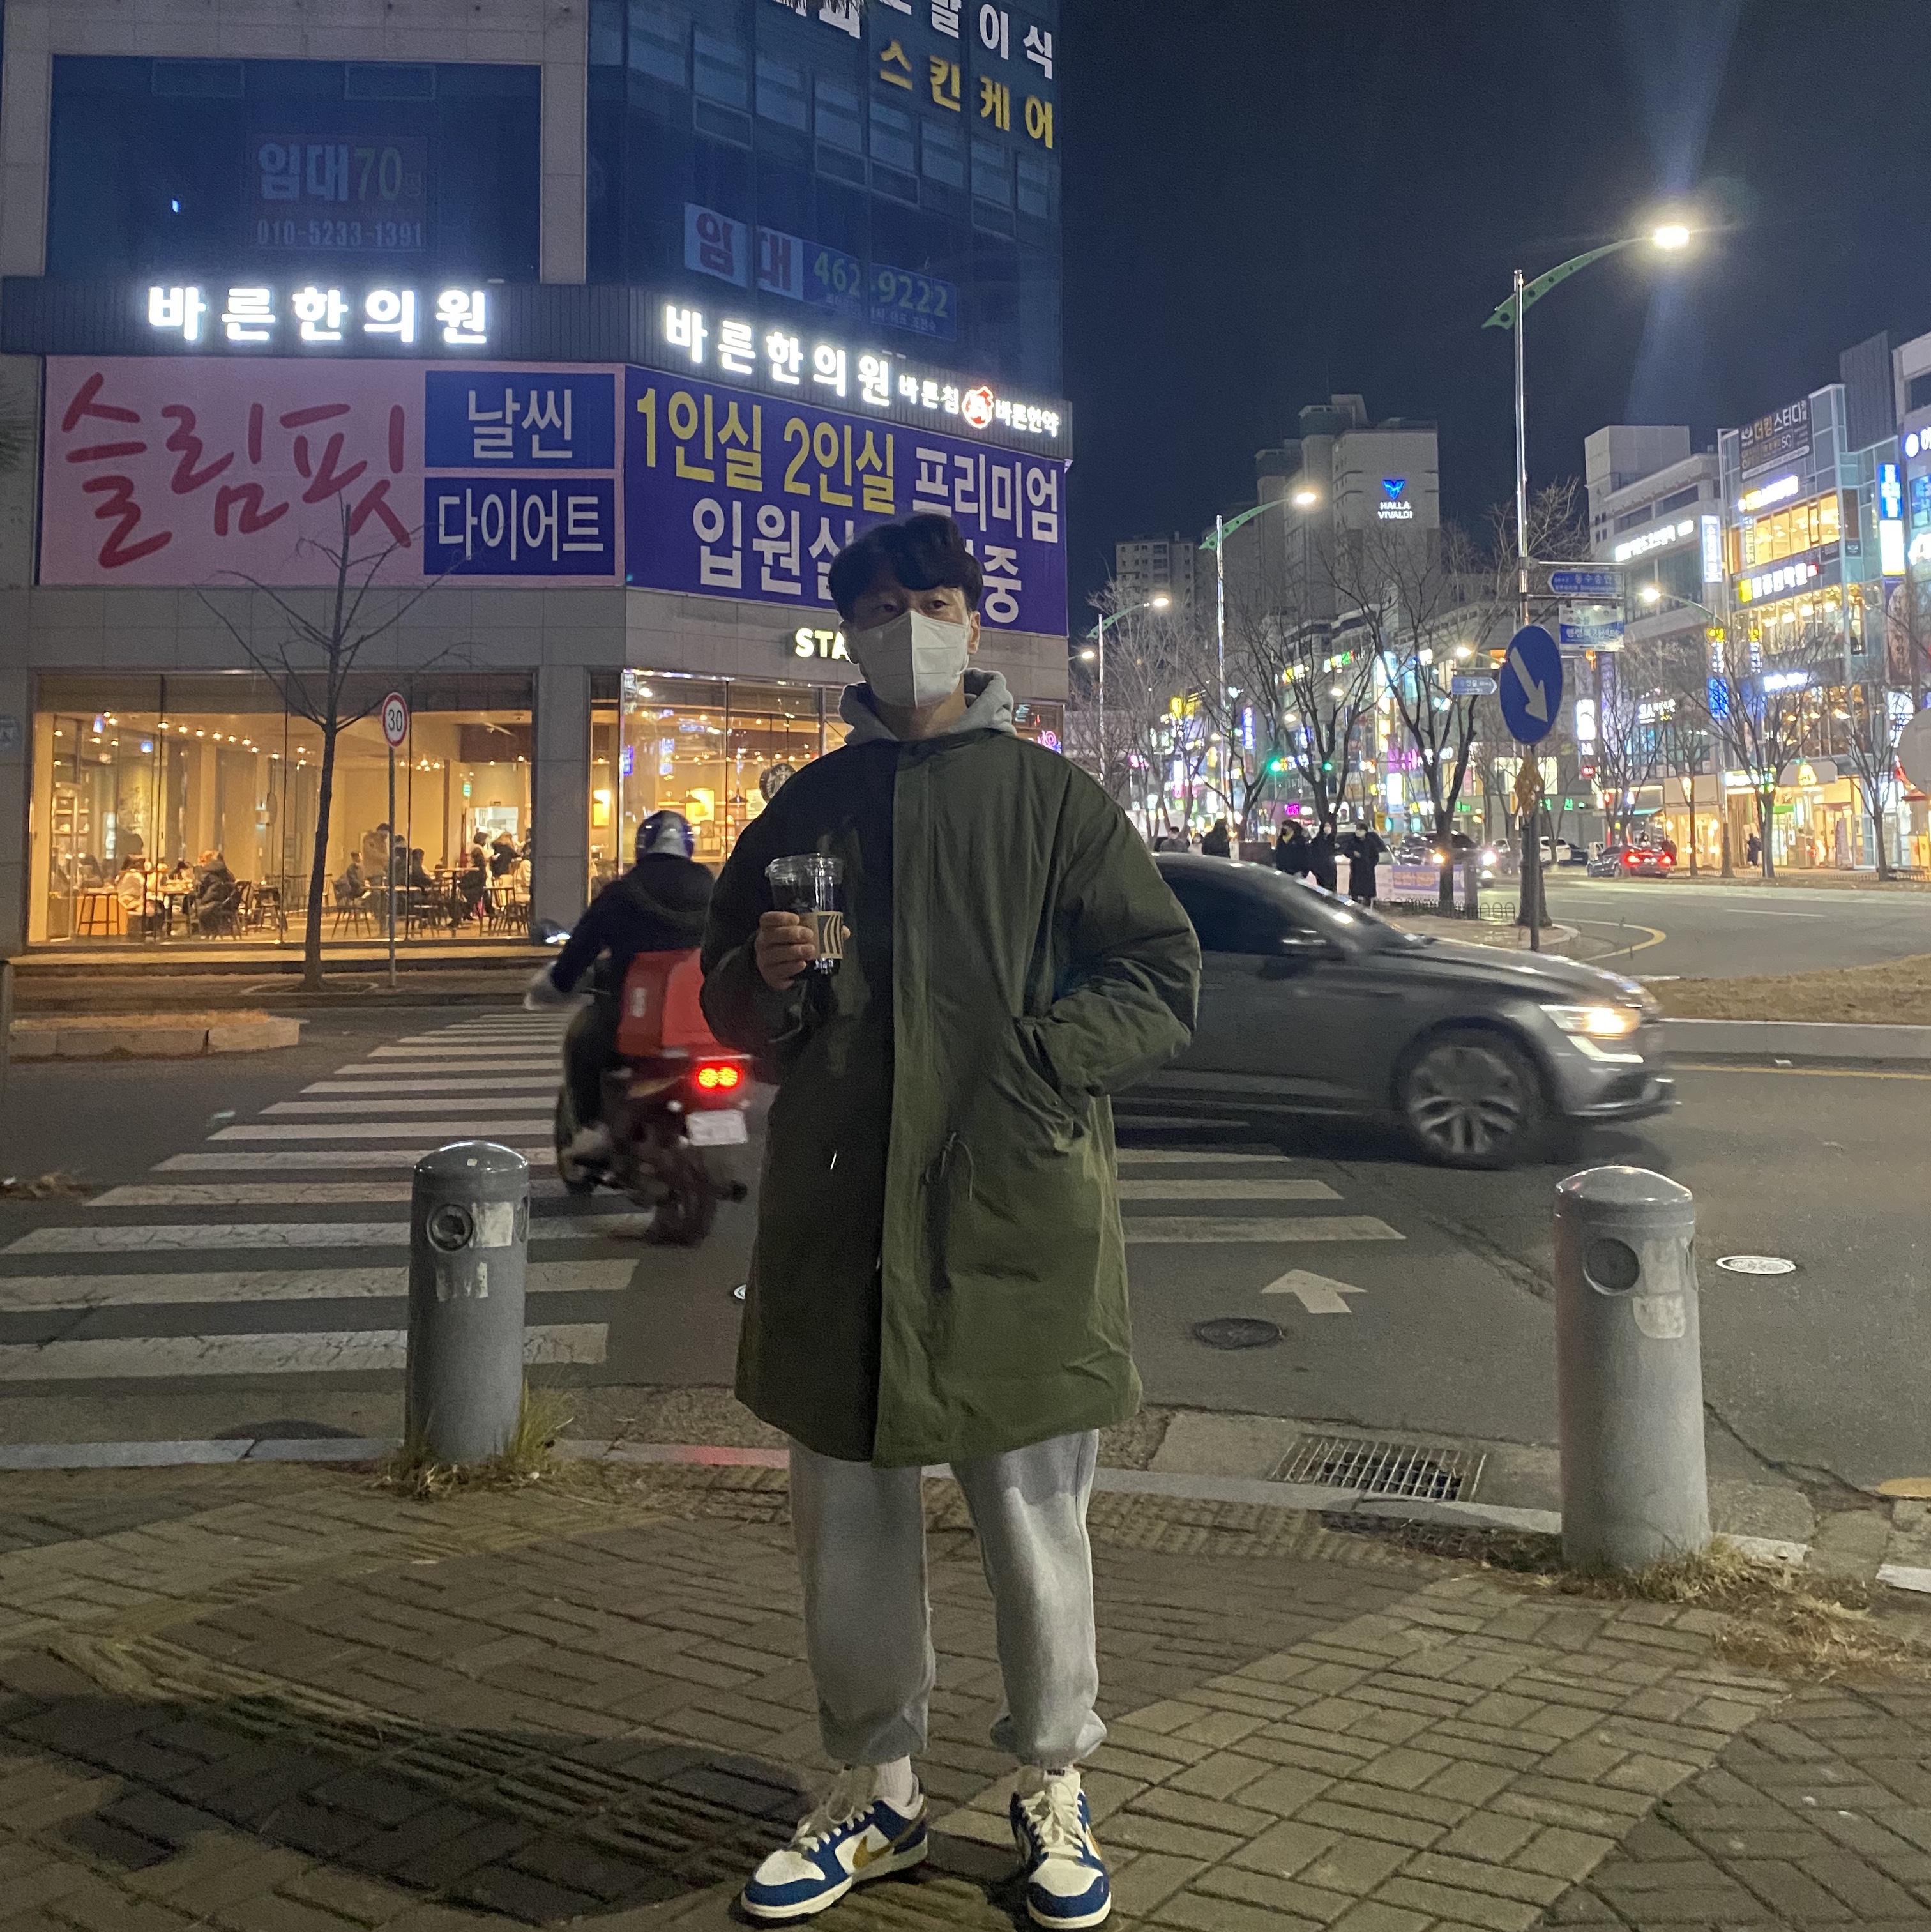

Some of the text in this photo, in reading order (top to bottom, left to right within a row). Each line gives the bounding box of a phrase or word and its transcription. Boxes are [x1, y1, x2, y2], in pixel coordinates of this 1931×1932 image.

[879, 0, 1052, 80] 발이식
[880, 38, 1053, 149] 스킨케어
[257, 142, 349, 201] 임대
[695, 212, 792, 291] 임대
[148, 286, 487, 344] 바른한의원
[665, 305, 891, 406] 바른한의원
[899, 374, 959, 415] 바른침
[995, 399, 1060, 438] 바른한약
[467, 389, 573, 459] 날씬
[61, 372, 412, 570] 슬림핏
[637, 388, 1058, 544] 1인실 2인실 프리미엄
[438, 488, 604, 561] 다이어트
[1377, 511, 1413, 519] VIVALDI
[1379, 501, 1411, 510] HALLA
[965, 539, 1022, 623] 중
[794, 627, 851, 660] STA
[388, 709, 403, 732] 30
